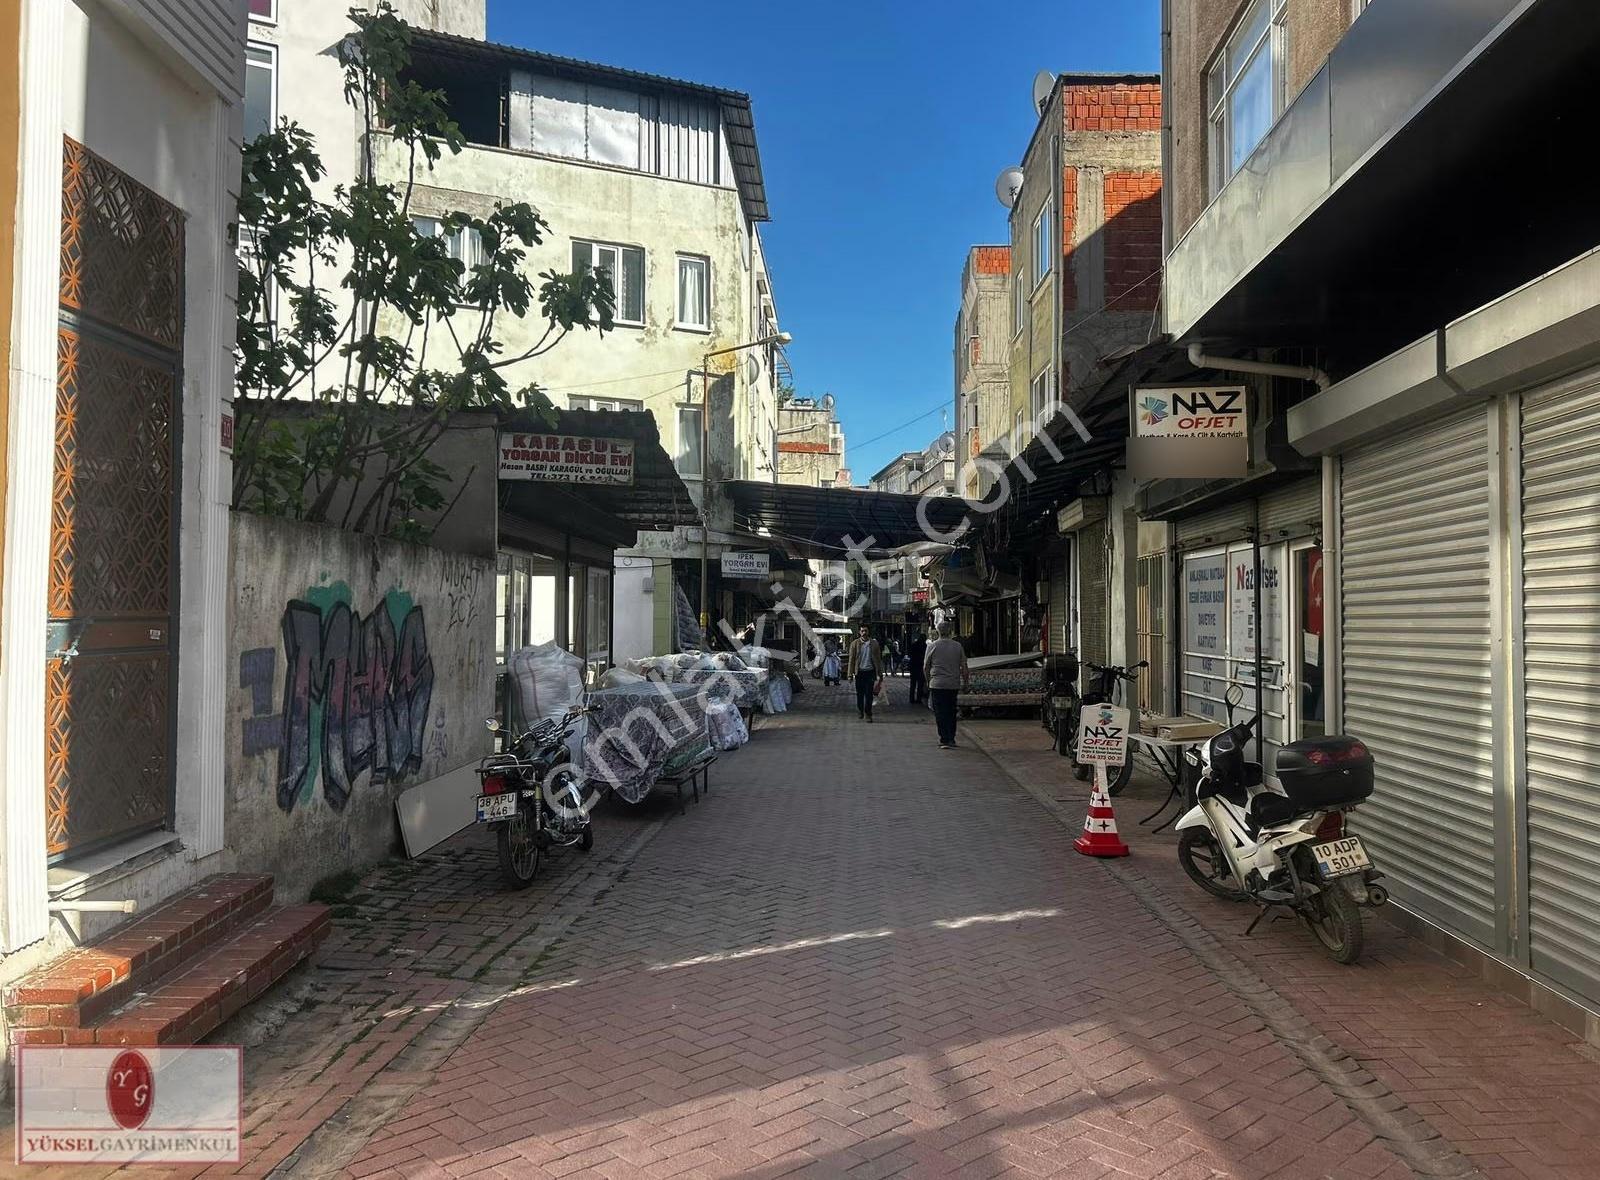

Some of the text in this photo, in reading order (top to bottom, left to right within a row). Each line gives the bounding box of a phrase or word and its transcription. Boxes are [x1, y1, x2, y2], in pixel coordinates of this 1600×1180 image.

[1172, 390, 1242, 415] NAZ
[1178, 416, 1238, 429] OFSET
[501, 448, 560, 462] YORGAN
[610, 454, 632, 466] EVİ
[501, 462, 523, 471] Hasan
[525, 463, 547, 471] BASRİ
[723, 560, 755, 568] YORGAN
[1236, 559, 1278, 590] Naz fset
[1084, 725, 1122, 739] NAZ
[1083, 738, 1122, 747] OFSET
[480, 794, 514, 807] 38 APU
[1315, 838, 1358, 858] 10 ADP
[1332, 854, 1356, 869] 501
